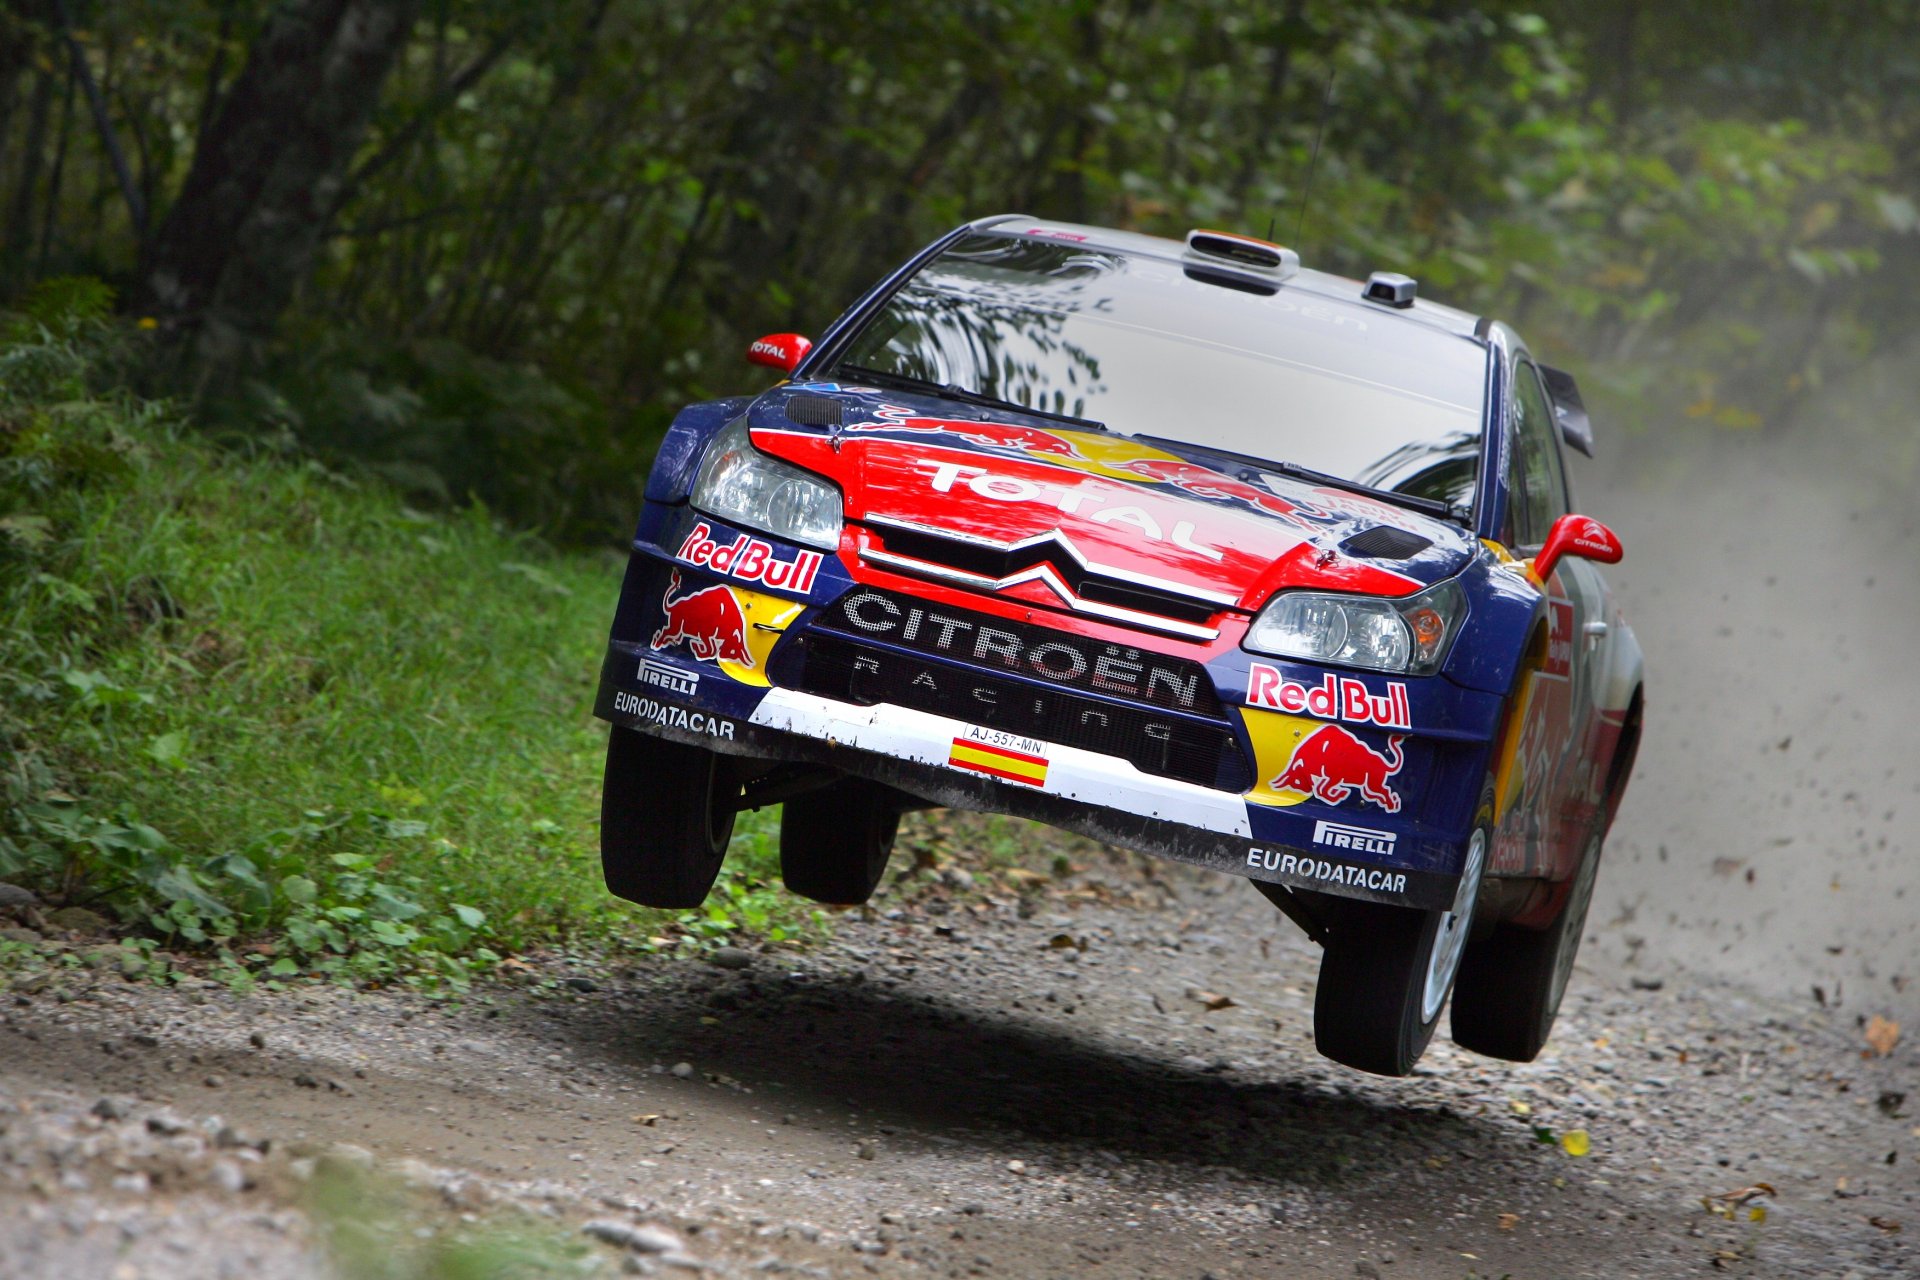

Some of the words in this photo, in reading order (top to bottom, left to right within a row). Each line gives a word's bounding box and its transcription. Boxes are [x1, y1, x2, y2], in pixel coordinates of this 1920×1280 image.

[750, 341, 787, 360] TOTAL
[916, 458, 1225, 562] TOTAL
[674, 522, 746, 578] Red
[730, 535, 824, 594] Bull
[843, 592, 1199, 707] CITROËN
[636, 658, 700, 696] PIRELLI
[1246, 662, 1337, 719] Red
[1340, 677, 1412, 729] Bull
[613, 691, 736, 742] EURODATACAR
[970, 726, 1042, 754] AJ-557-MN
[1312, 820, 1397, 856] PIRELLI
[1246, 847, 1407, 893] EURODATACAR
